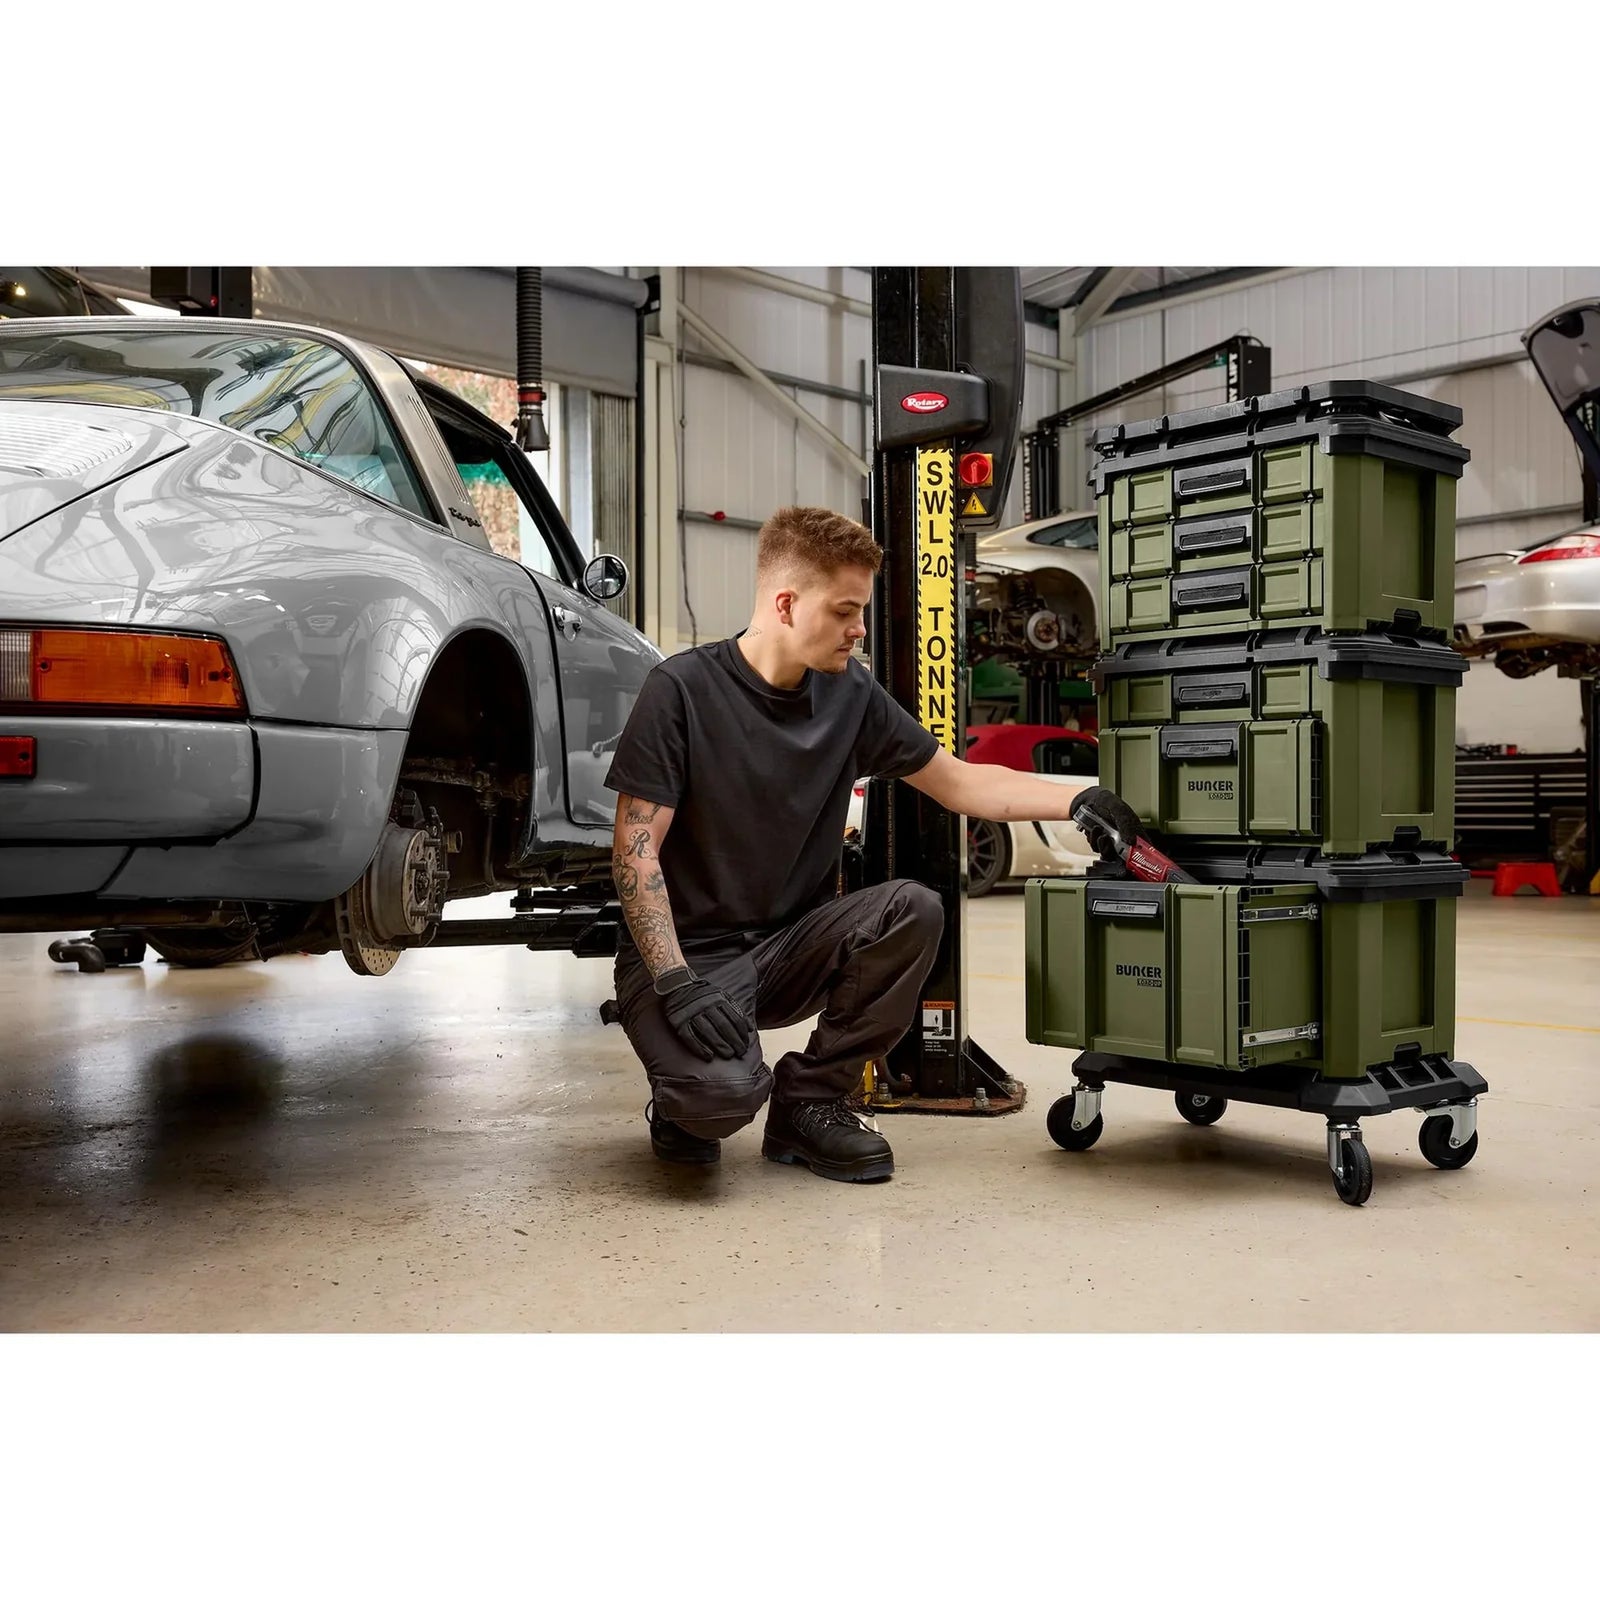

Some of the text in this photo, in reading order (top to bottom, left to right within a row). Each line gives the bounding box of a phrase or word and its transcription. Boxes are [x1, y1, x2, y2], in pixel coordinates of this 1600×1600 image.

[907, 398, 944, 410] Rotary
[921, 461, 948, 748] SWL 2.0 TONNE
[1188, 780, 1233, 791] BUNKER
[1116, 964, 1161, 978] BUNKER
